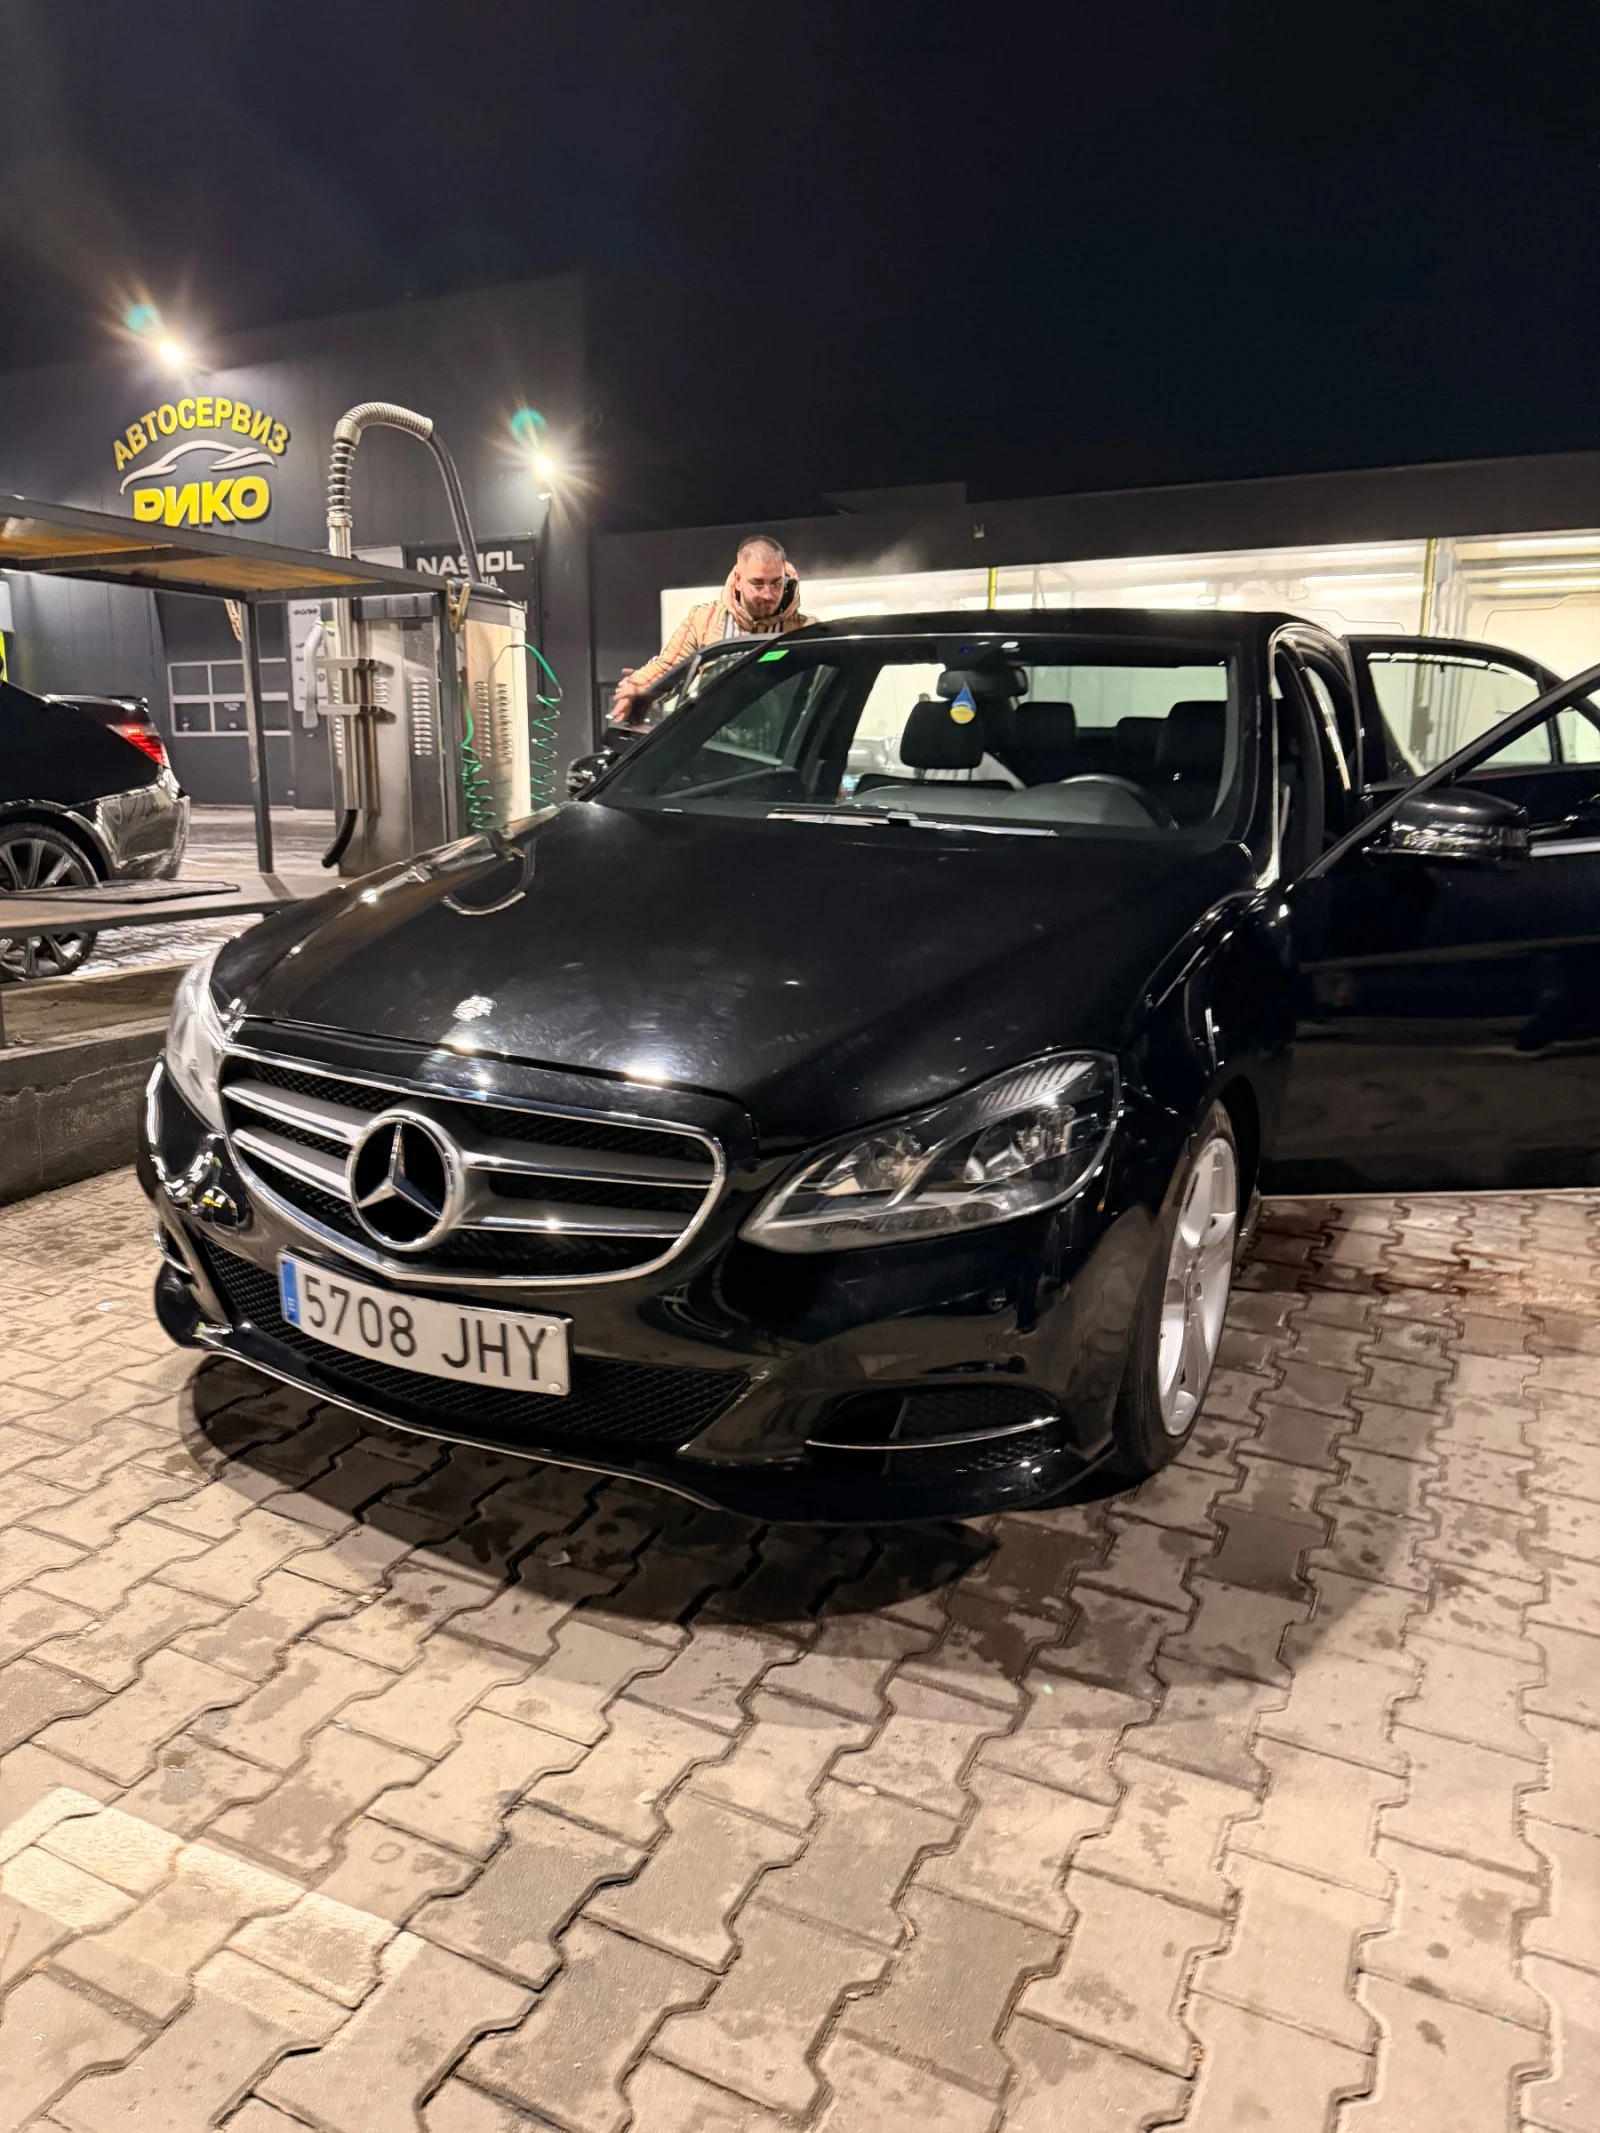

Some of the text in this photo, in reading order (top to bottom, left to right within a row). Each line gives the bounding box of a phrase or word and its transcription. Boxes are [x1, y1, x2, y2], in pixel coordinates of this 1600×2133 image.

[112, 396, 288, 471] АВТОСЕРВИЗ
[416, 550, 525, 576] NASIOL
[304, 1274, 546, 1381] 5708 JHY
